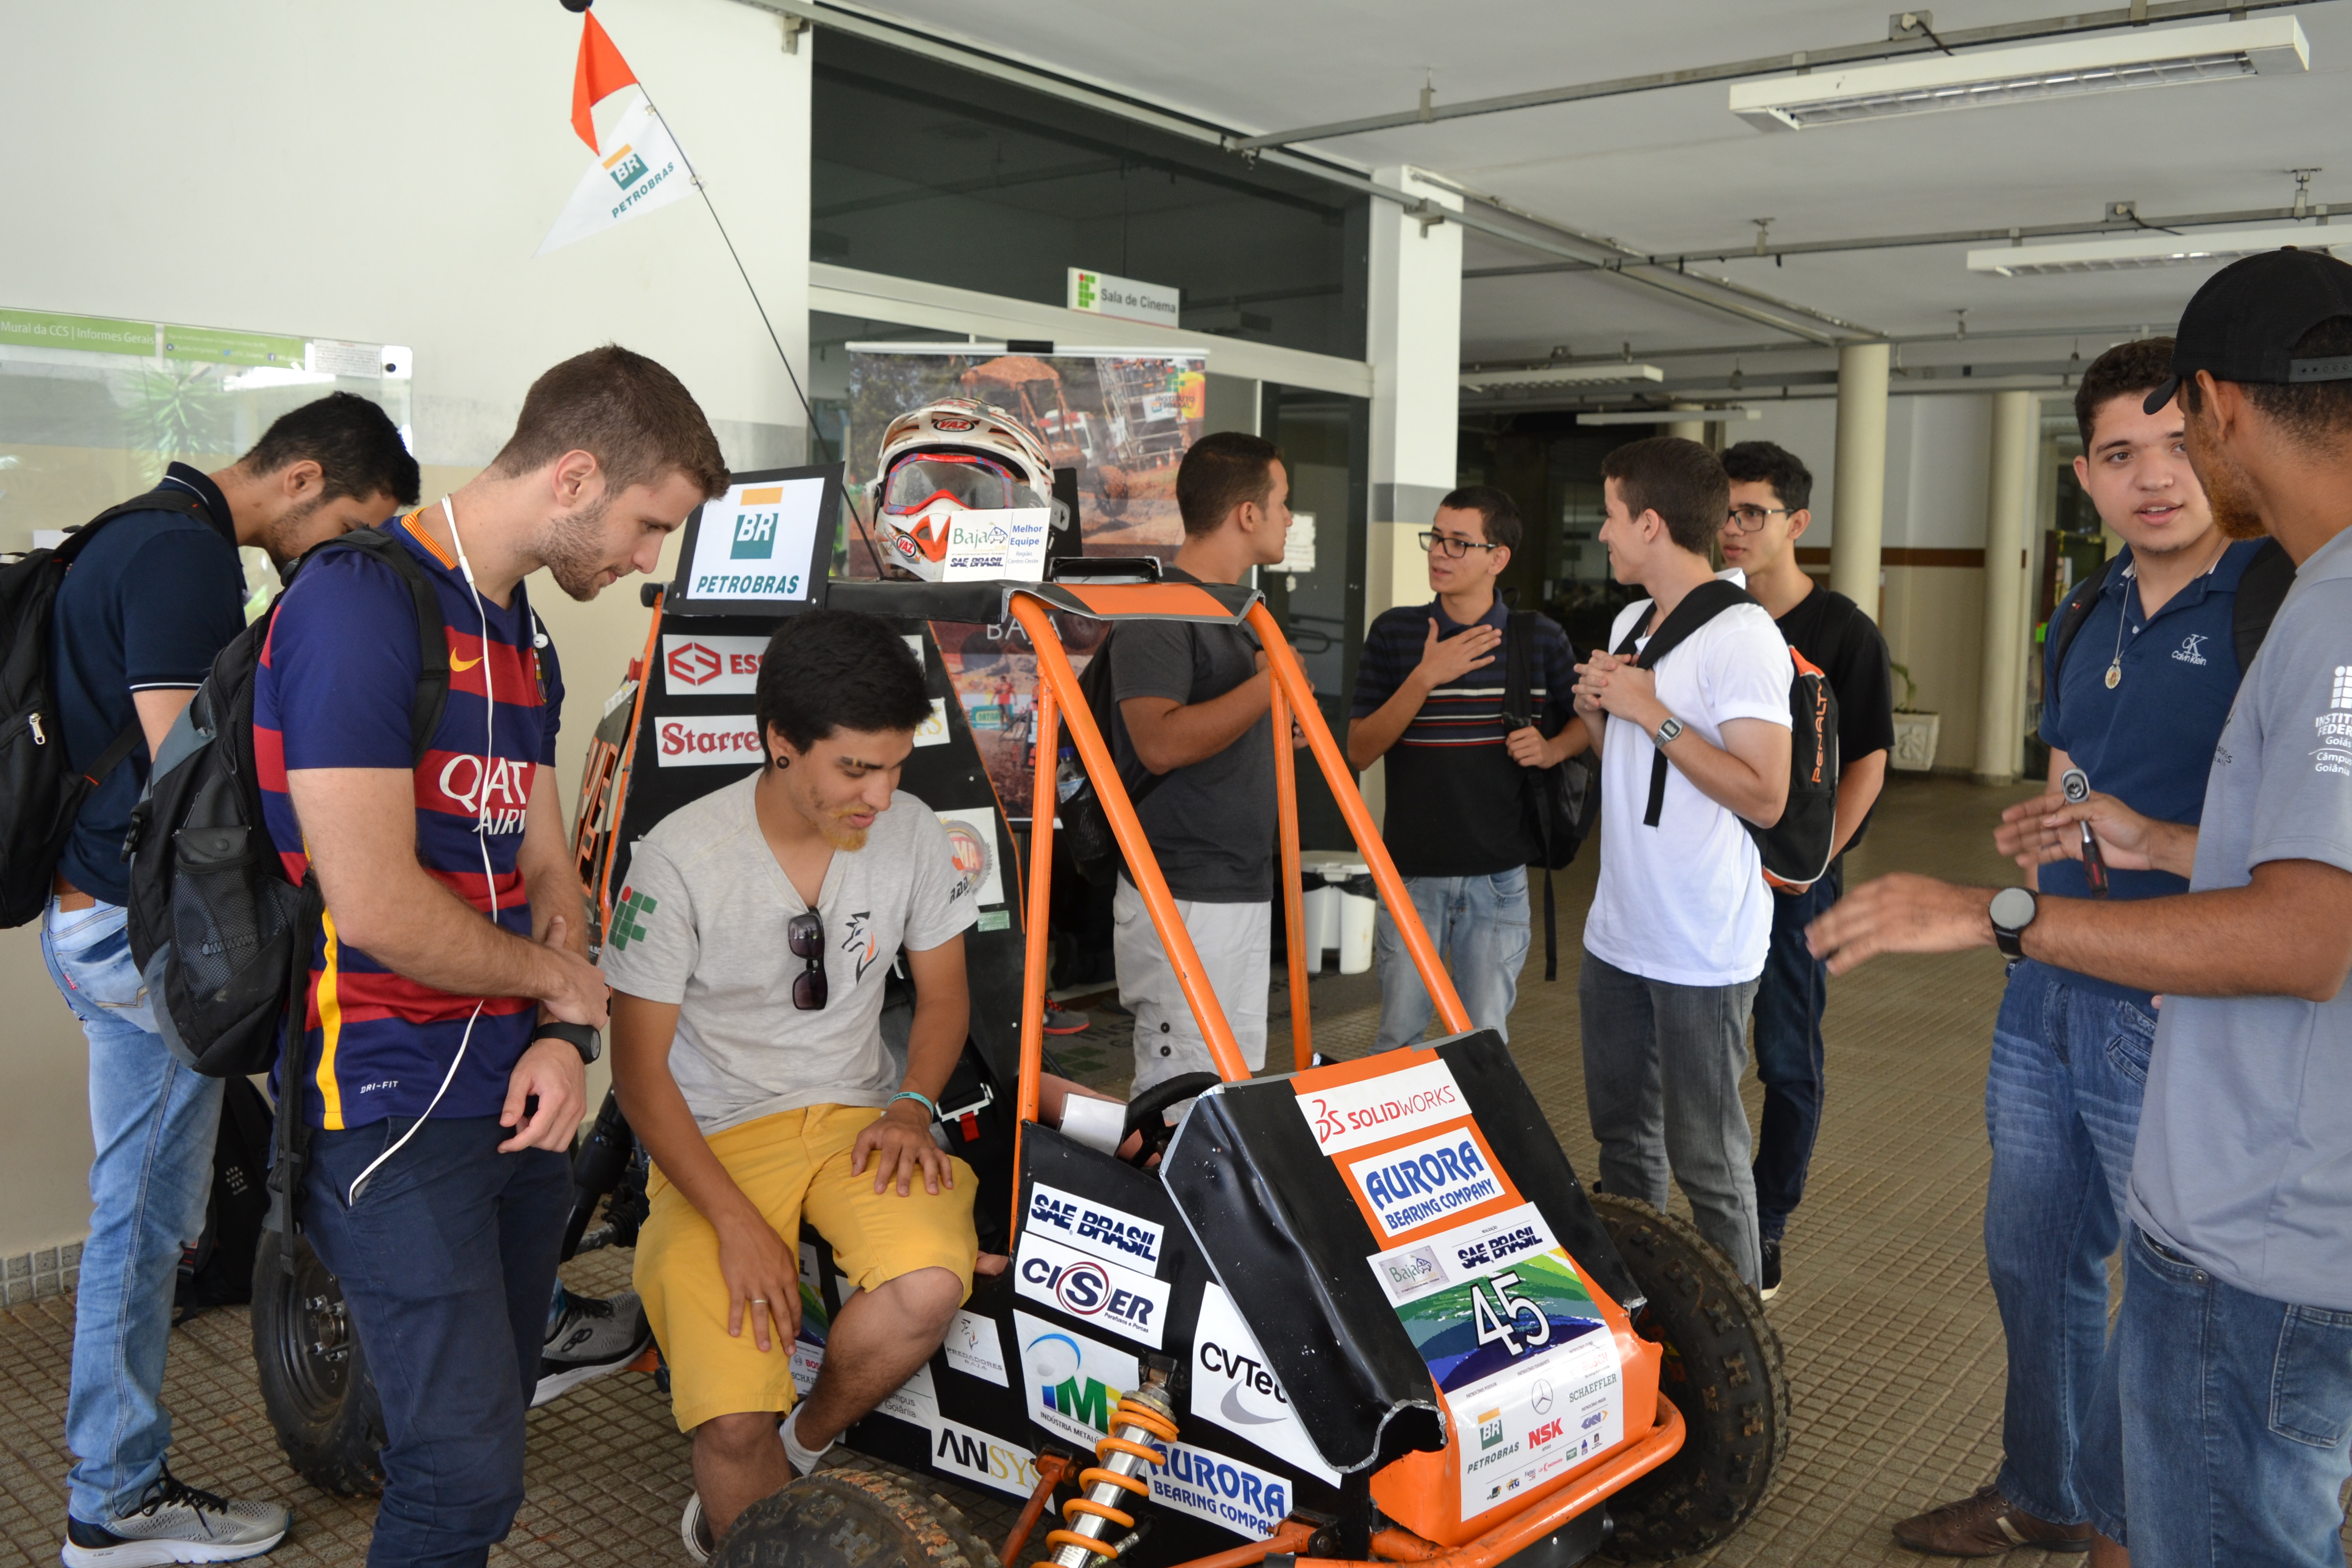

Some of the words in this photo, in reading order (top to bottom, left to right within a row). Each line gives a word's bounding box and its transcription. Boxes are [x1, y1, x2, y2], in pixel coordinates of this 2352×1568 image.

[611, 162, 674, 218] PETROBRAS
[1101, 288, 1122, 304] Sala
[1125, 293, 1137, 305] de
[1140, 296, 1176, 312] Cinema
[1, 321, 31, 333] Mural
[34, 324, 46, 334] da
[50, 325, 69, 336] CCS
[77, 328, 122, 341] Informes
[124, 332, 155, 345] Gerais
[934, 421, 969, 429] VAZ
[736, 512, 775, 542] BR
[1012, 525, 1042, 533] Melhor
[898, 538, 915, 554] VAZ
[953, 528, 988, 549] Baja
[1010, 537, 1039, 547] Equipe
[950, 558, 969, 568] SAE
[970, 557, 1003, 567] BRASIL
[696, 575, 799, 594] PETROBRAS
[2172, 650, 2191, 663] Calvin
[2190, 655, 2207, 666] Klein
[2325, 736, 2351, 748] Goiás
[2315, 763, 2350, 776] Goiânia
[2316, 752, 2352, 766] Câmpus
[360, 1081, 398, 1094] DRI-FIT
[1348, 1085, 1456, 1130] SOLIDWORKS
[1366, 1140, 1485, 1211] AURORA
[1385, 1198, 1442, 1230] BEARING
[1439, 1178, 1496, 1209] COMPANY
[1031, 1194, 1078, 1231] SAE
[1076, 1210, 1157, 1262] BRASIL
[1457, 1242, 1491, 1269] SAE
[1488, 1226, 1544, 1260] BRASIL
[1389, 1264, 1420, 1283] Baja
[1022, 1258, 1154, 1326] CISER
[1105, 1312, 1128, 1326] Parafusos
[1132, 1322, 1149, 1333] Porcas
[1470, 1270, 1551, 1356] 45
[946, 1347, 1003, 1370] PREDADORES
[964, 1359, 987, 1370] BAJA
[1582, 1352, 1608, 1371] BOSCH
[1569, 1373, 1618, 1403] SCHAEFFLER
[885, 1400, 916, 1418] Goiânia
[1040, 1411, 1072, 1433] INDÚSTRIA
[1482, 1420, 1501, 1442] BR
[1528, 1417, 1563, 1450] NSK
[1467, 1441, 1520, 1474] PETROBRAS
[1148, 1443, 1285, 1518] AURORA
[1154, 1480, 1217, 1514] BEARING
